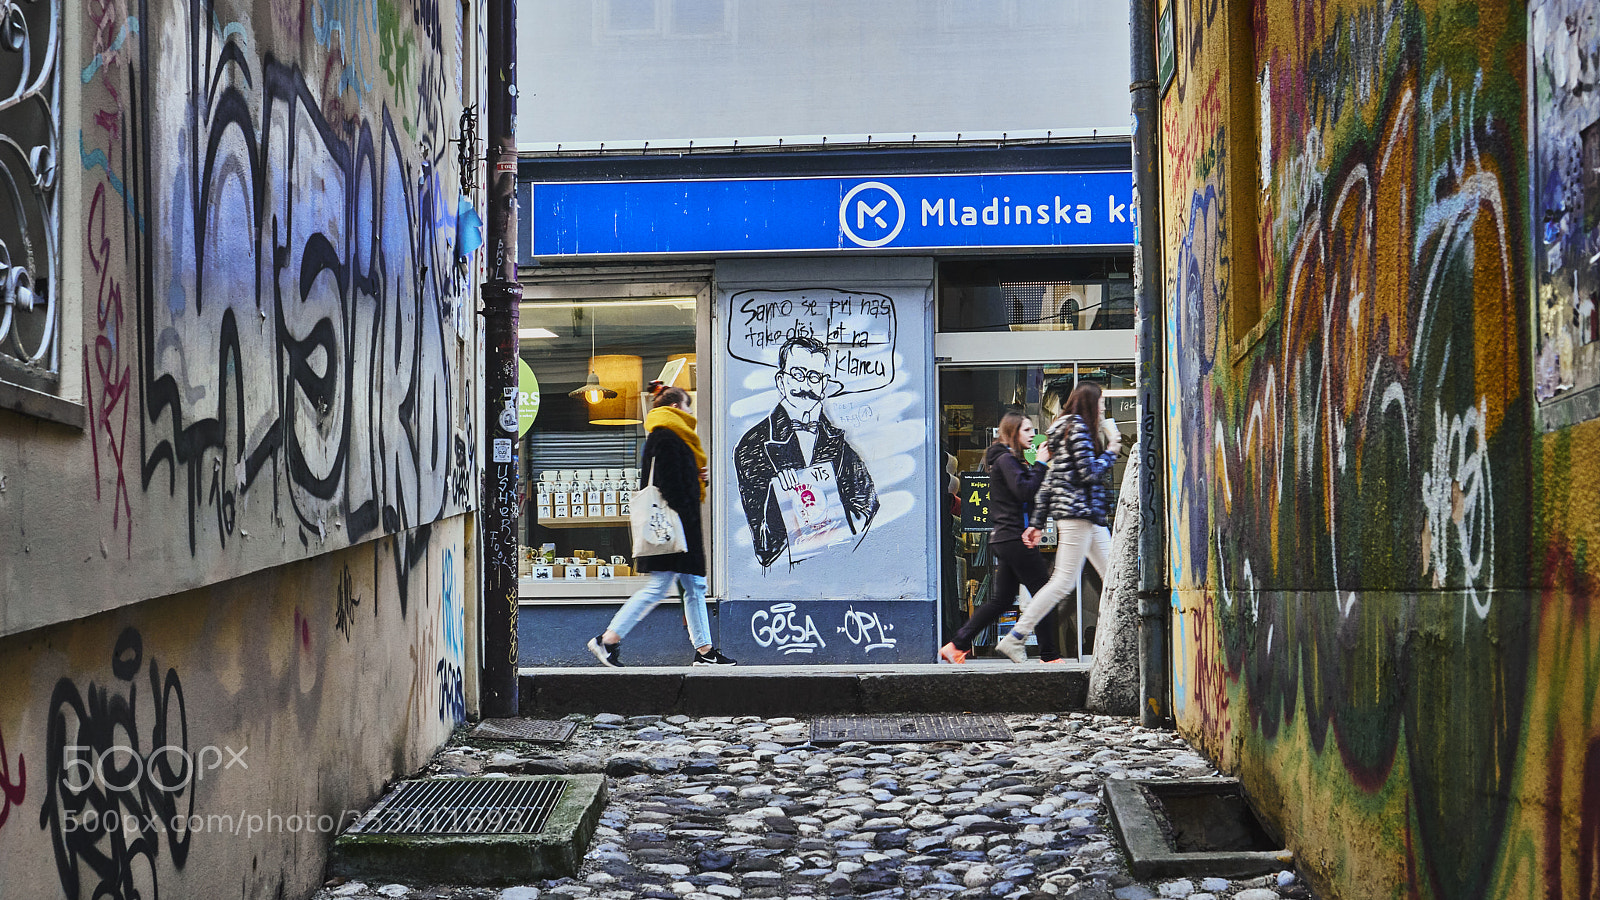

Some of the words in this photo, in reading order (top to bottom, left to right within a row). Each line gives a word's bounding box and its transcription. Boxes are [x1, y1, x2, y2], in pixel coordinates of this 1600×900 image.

[921, 194, 1092, 227] Mladinska
[1108, 194, 1135, 224] k
[740, 298, 793, 325] Samo
[829, 296, 852, 325] pri
[860, 298, 890, 319] nas
[968, 490, 982, 506] 4
[982, 506, 989, 515] 8
